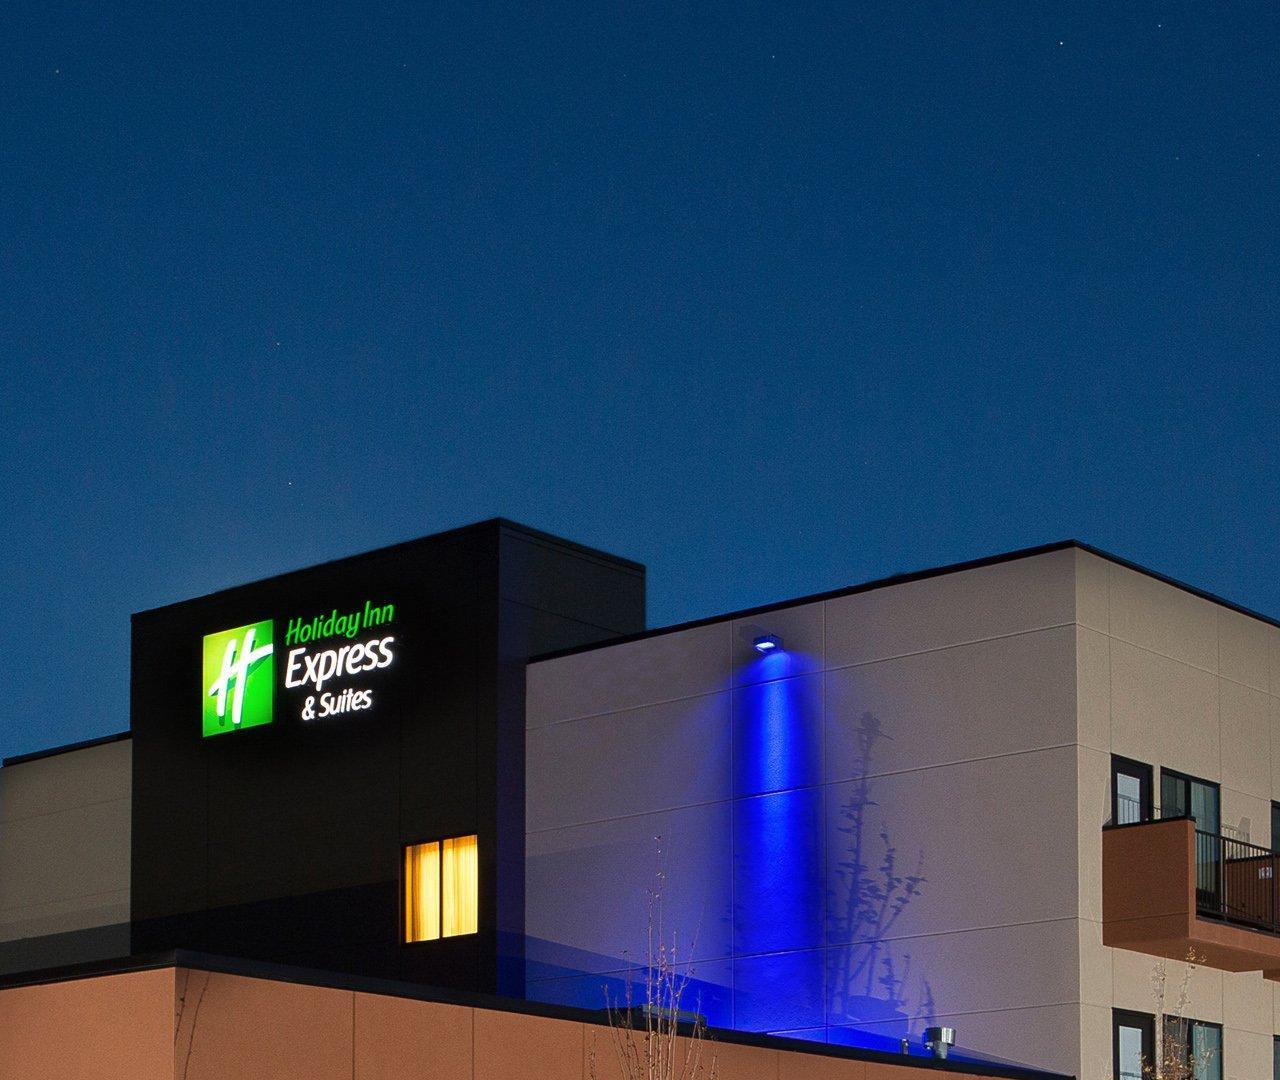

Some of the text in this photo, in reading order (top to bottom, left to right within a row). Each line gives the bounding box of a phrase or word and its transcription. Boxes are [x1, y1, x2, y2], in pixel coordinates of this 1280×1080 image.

[285, 600, 395, 646] Holiday Inn
[285, 636, 395, 692] Express
[301, 687, 373, 721] & Suites
